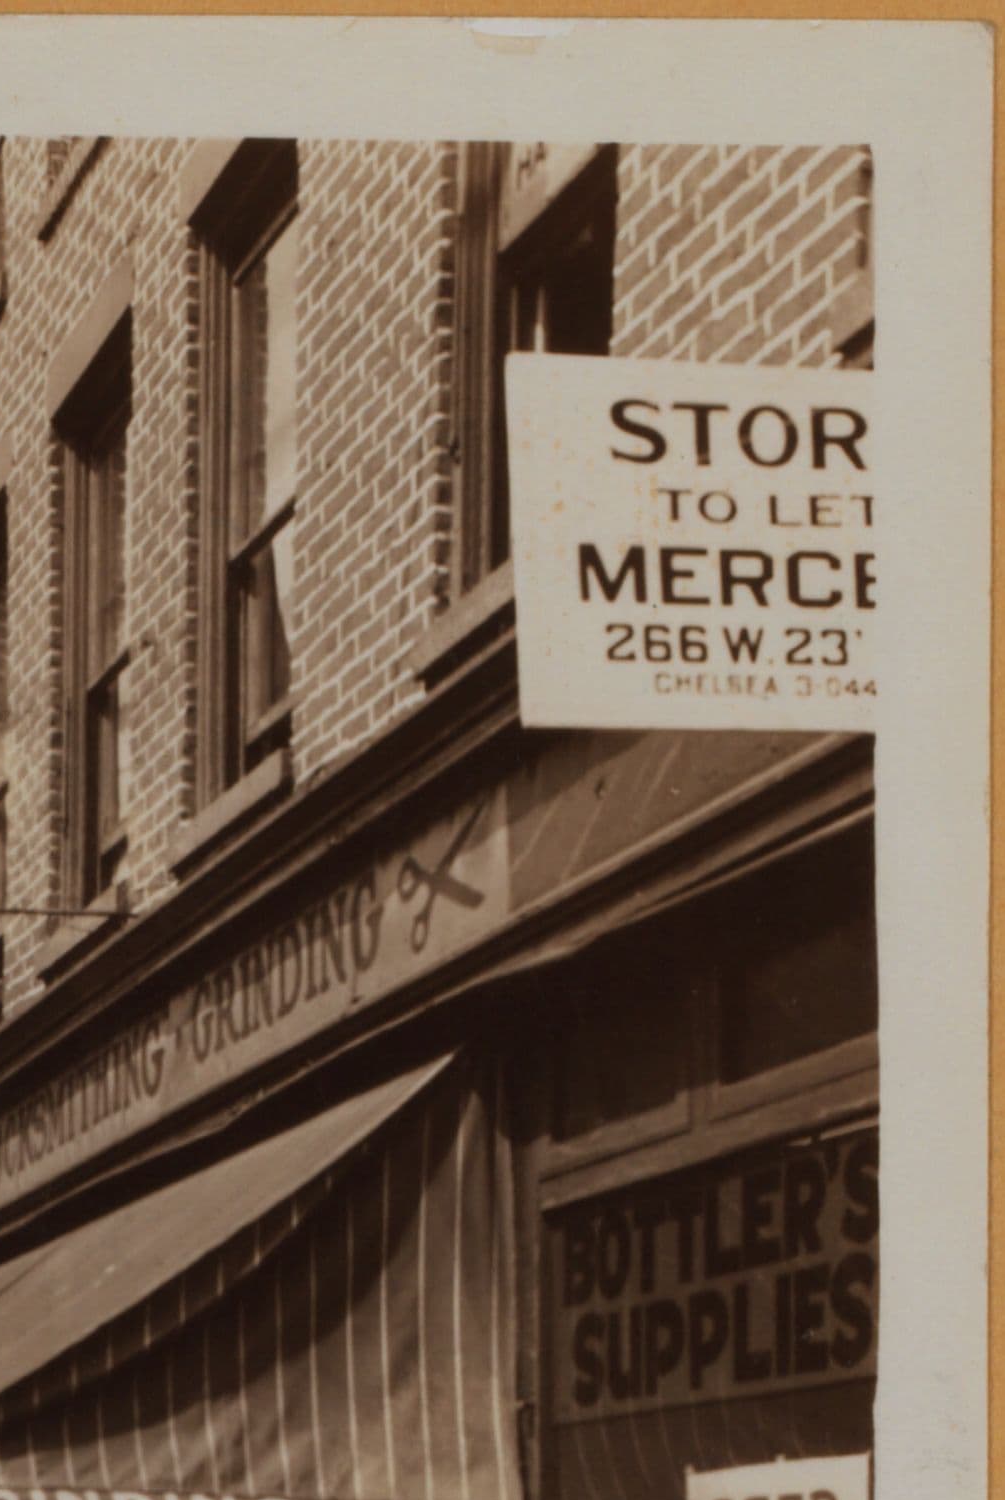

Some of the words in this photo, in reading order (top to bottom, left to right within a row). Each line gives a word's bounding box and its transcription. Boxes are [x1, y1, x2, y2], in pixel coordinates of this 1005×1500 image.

[656, 488, 737, 523] TO
[768, 494, 875, 528] LET
[577, 542, 877, 610] MERCE
[605, 623, 709, 664] 266
[654, 672, 779, 698] CHELSEA
[192, 866, 385, 1065] GRINDING
[572, 1251, 875, 1408] SUPPLIES
